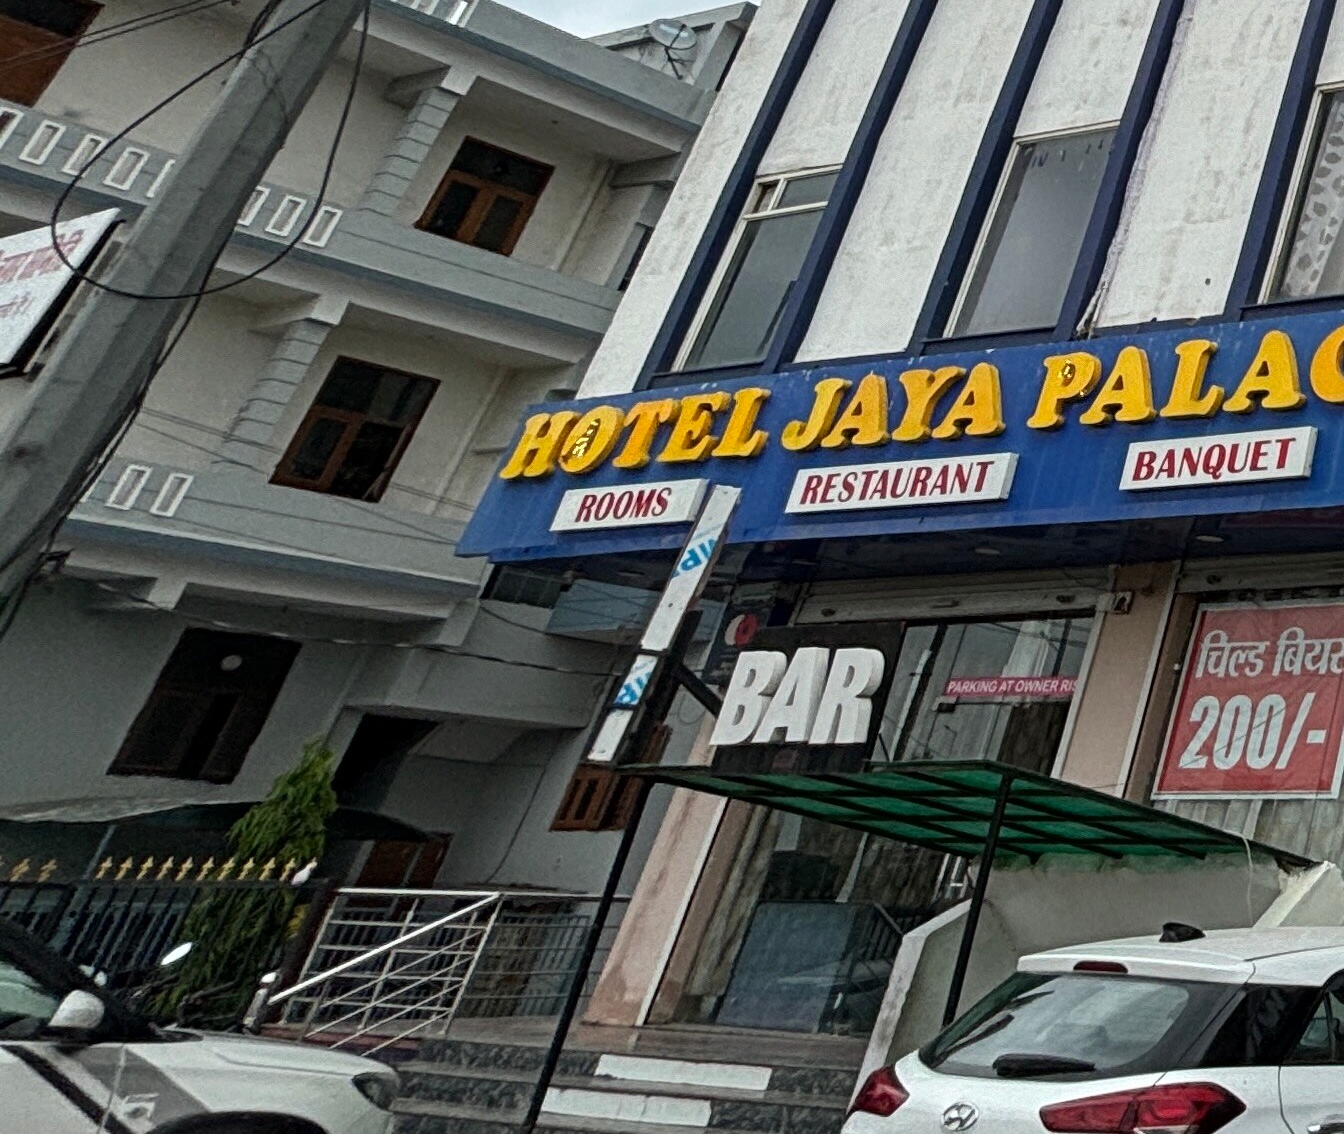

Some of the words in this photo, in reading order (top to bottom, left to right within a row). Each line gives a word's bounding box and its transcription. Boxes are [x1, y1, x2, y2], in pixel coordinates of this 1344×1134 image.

[500, 387, 771, 480] HOTEL
[781, 361, 1006, 452] JAYA
[1132, 437, 1296, 481] BANQUET
[575, 487, 672, 523] ROOMS
[801, 461, 995, 505] RESTAURANT
[1195, 629, 1270, 678] चिल्ड
[710, 646, 884, 745] BAR
[947, 680, 998, 694] PARKING
[999, 680, 1015, 693] AT
[1015, 679, 1058, 693] OWNER
[1060, 679, 1078, 692] RIS
[1178, 692, 1327, 770] 200/-
